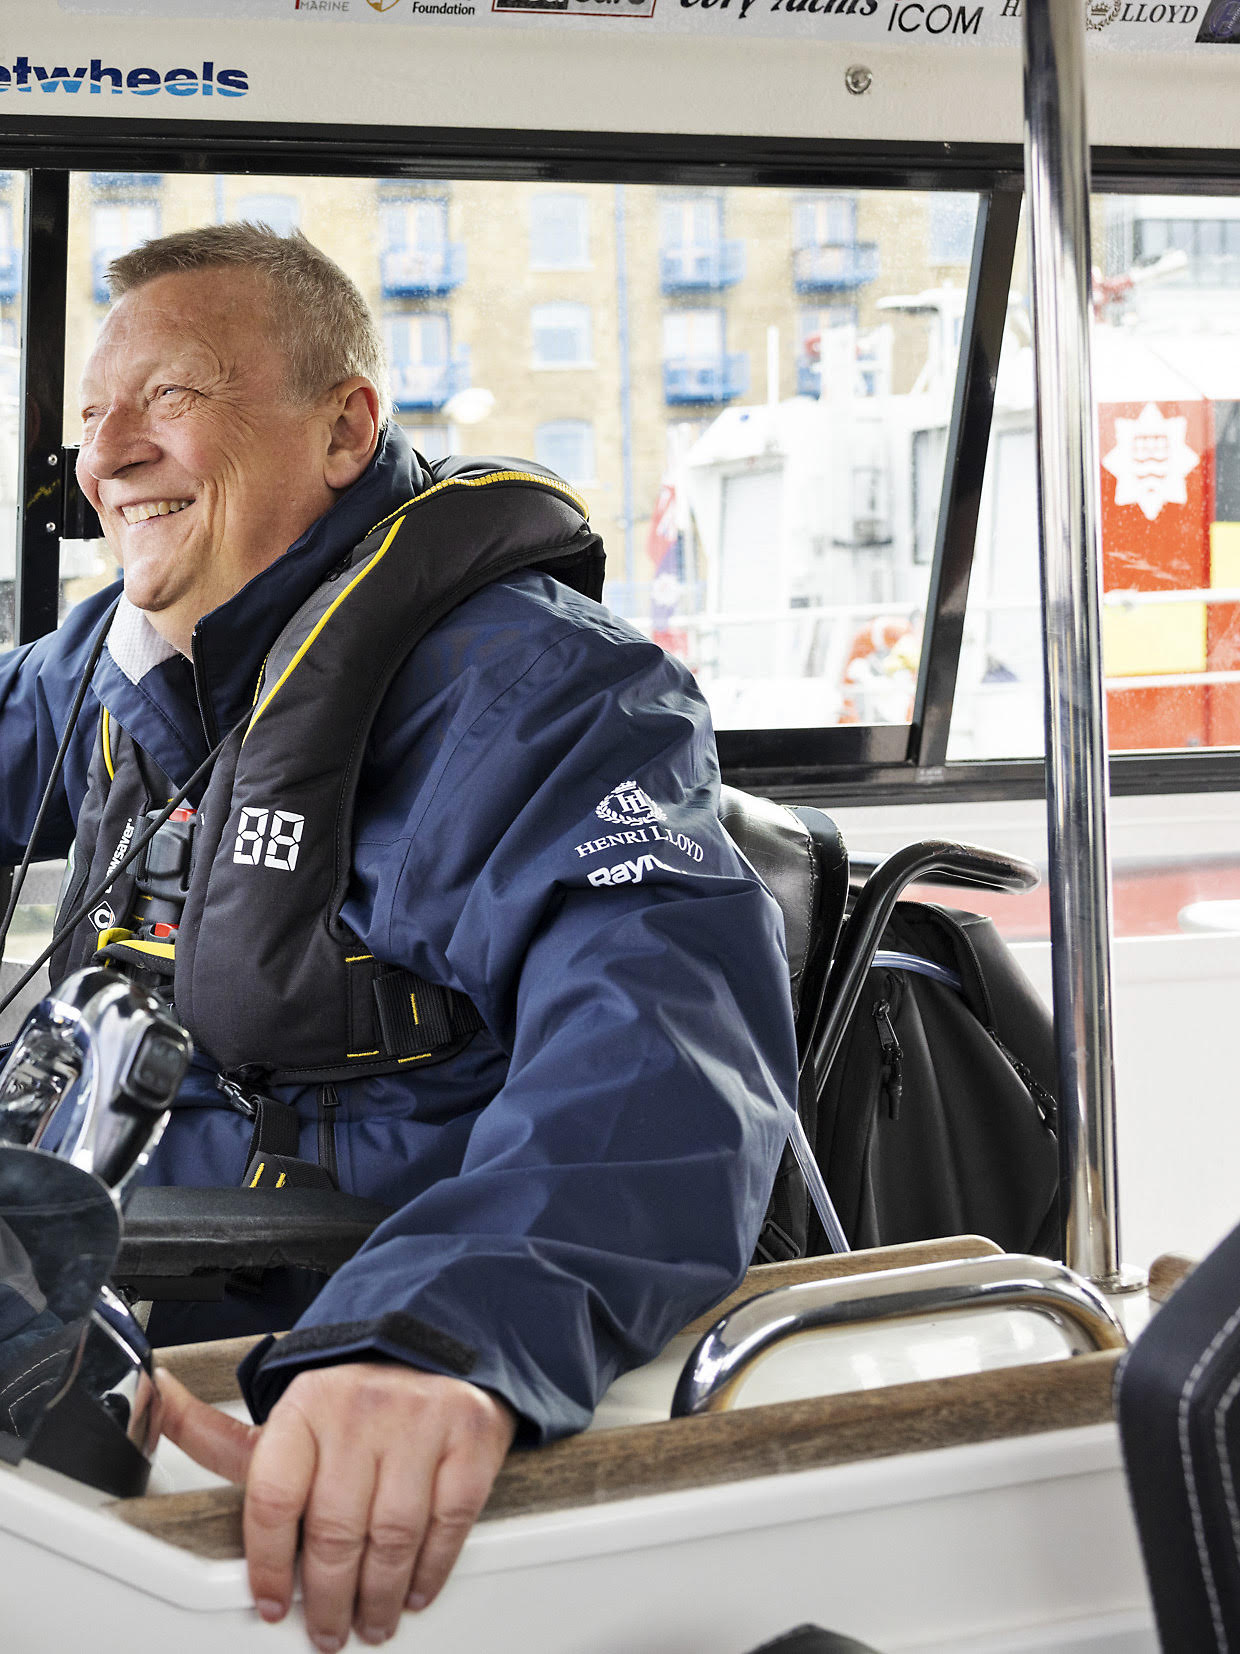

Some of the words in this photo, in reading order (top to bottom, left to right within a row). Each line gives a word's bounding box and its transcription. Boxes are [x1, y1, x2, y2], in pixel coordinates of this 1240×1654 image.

[300, 1, 350, 12] MARINE
[412, 2, 476, 15] Foundation
[1119, 3, 1199, 24] LLOYD
[575, 829, 650, 857] HENRI
[649, 825, 705, 863] LLOYD
